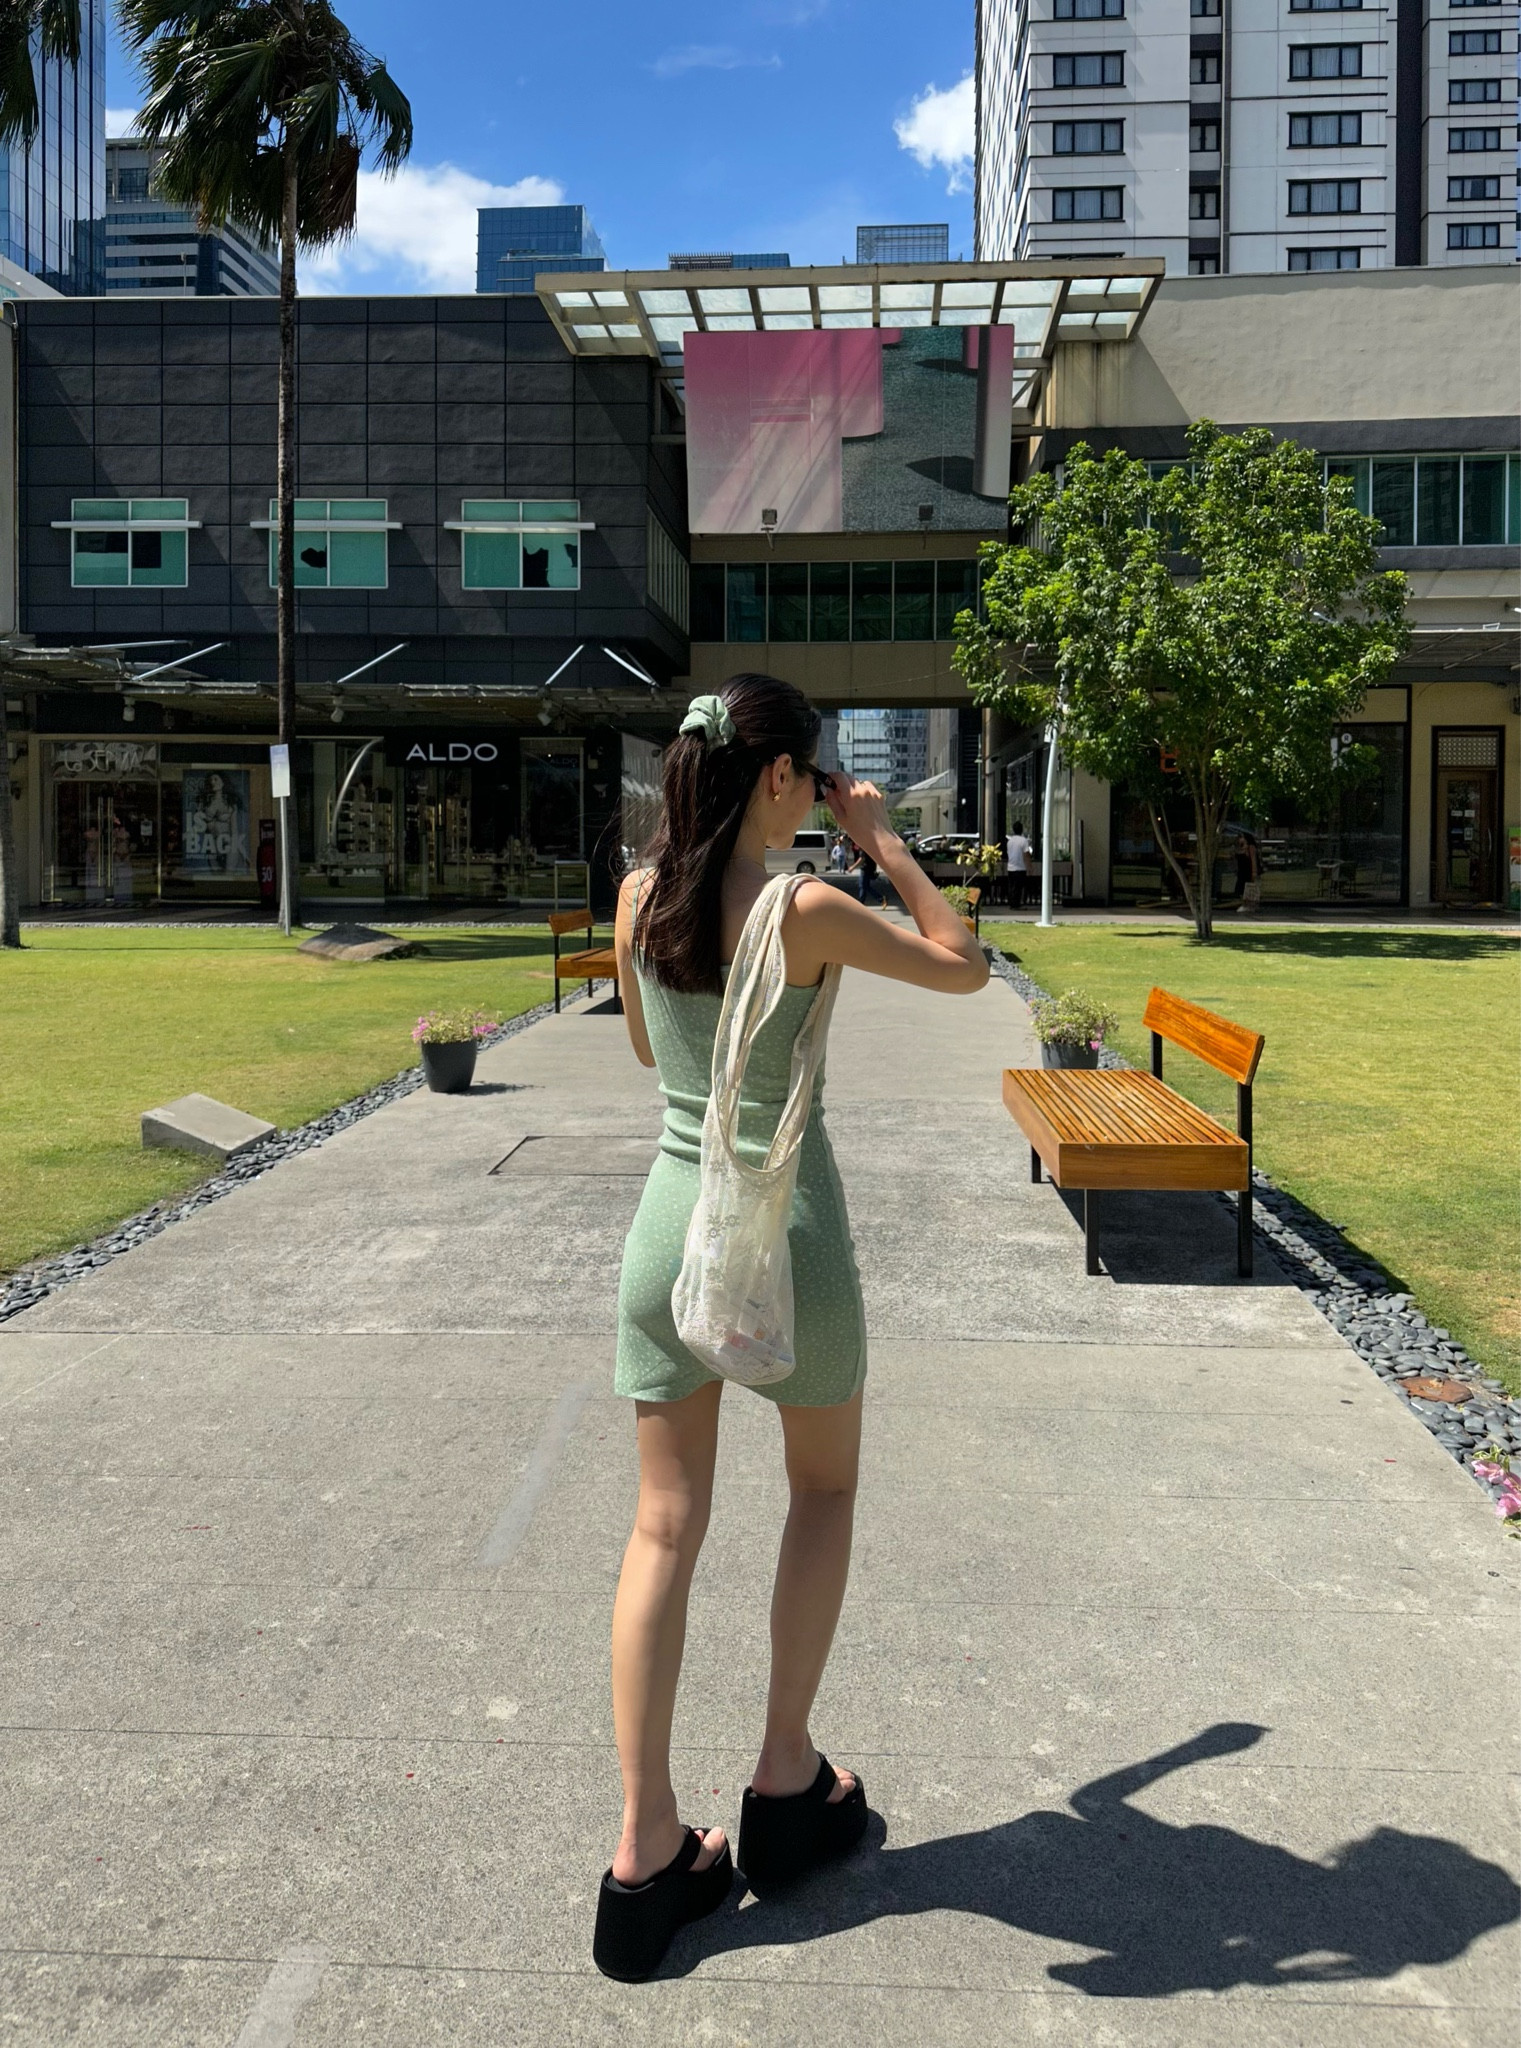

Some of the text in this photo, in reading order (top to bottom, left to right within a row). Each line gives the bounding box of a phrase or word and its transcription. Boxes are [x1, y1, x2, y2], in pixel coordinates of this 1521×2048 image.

[405, 743, 498, 762] ALDO
[185, 811, 207, 833] IS
[183, 832, 248, 855] BACK
